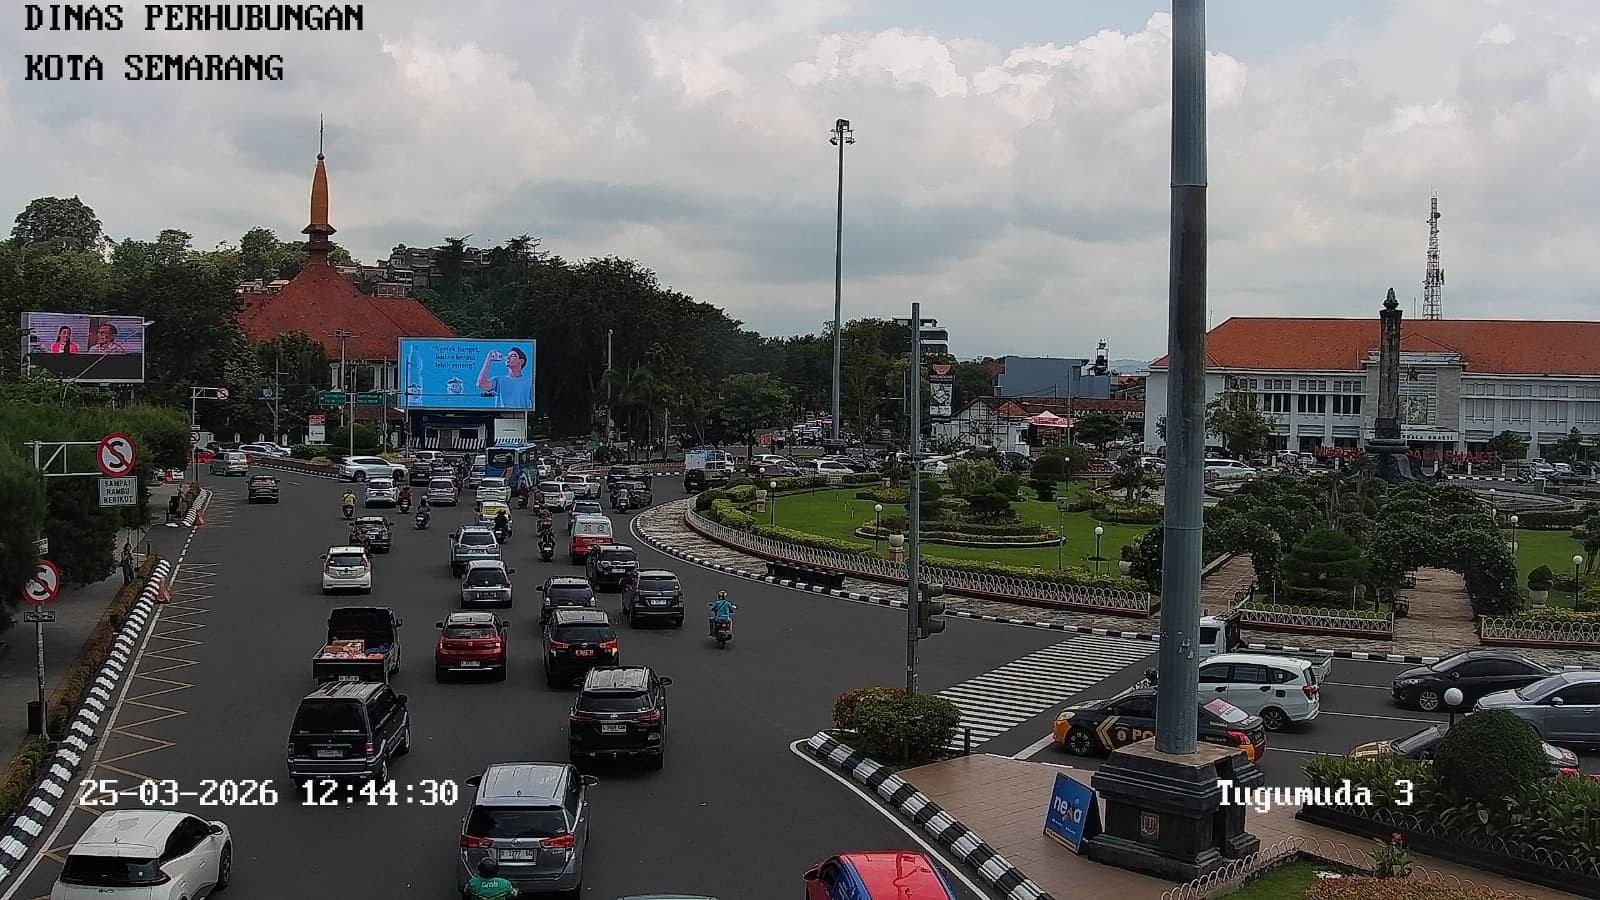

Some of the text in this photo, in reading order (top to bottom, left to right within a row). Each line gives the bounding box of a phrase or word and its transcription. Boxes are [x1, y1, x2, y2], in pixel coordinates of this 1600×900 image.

[104, 479, 131, 487] SAMPAI
[107, 488, 130, 496] RAMBU
[103, 496, 133, 504] BERIKUT
[481, 881, 499, 889] Grab
